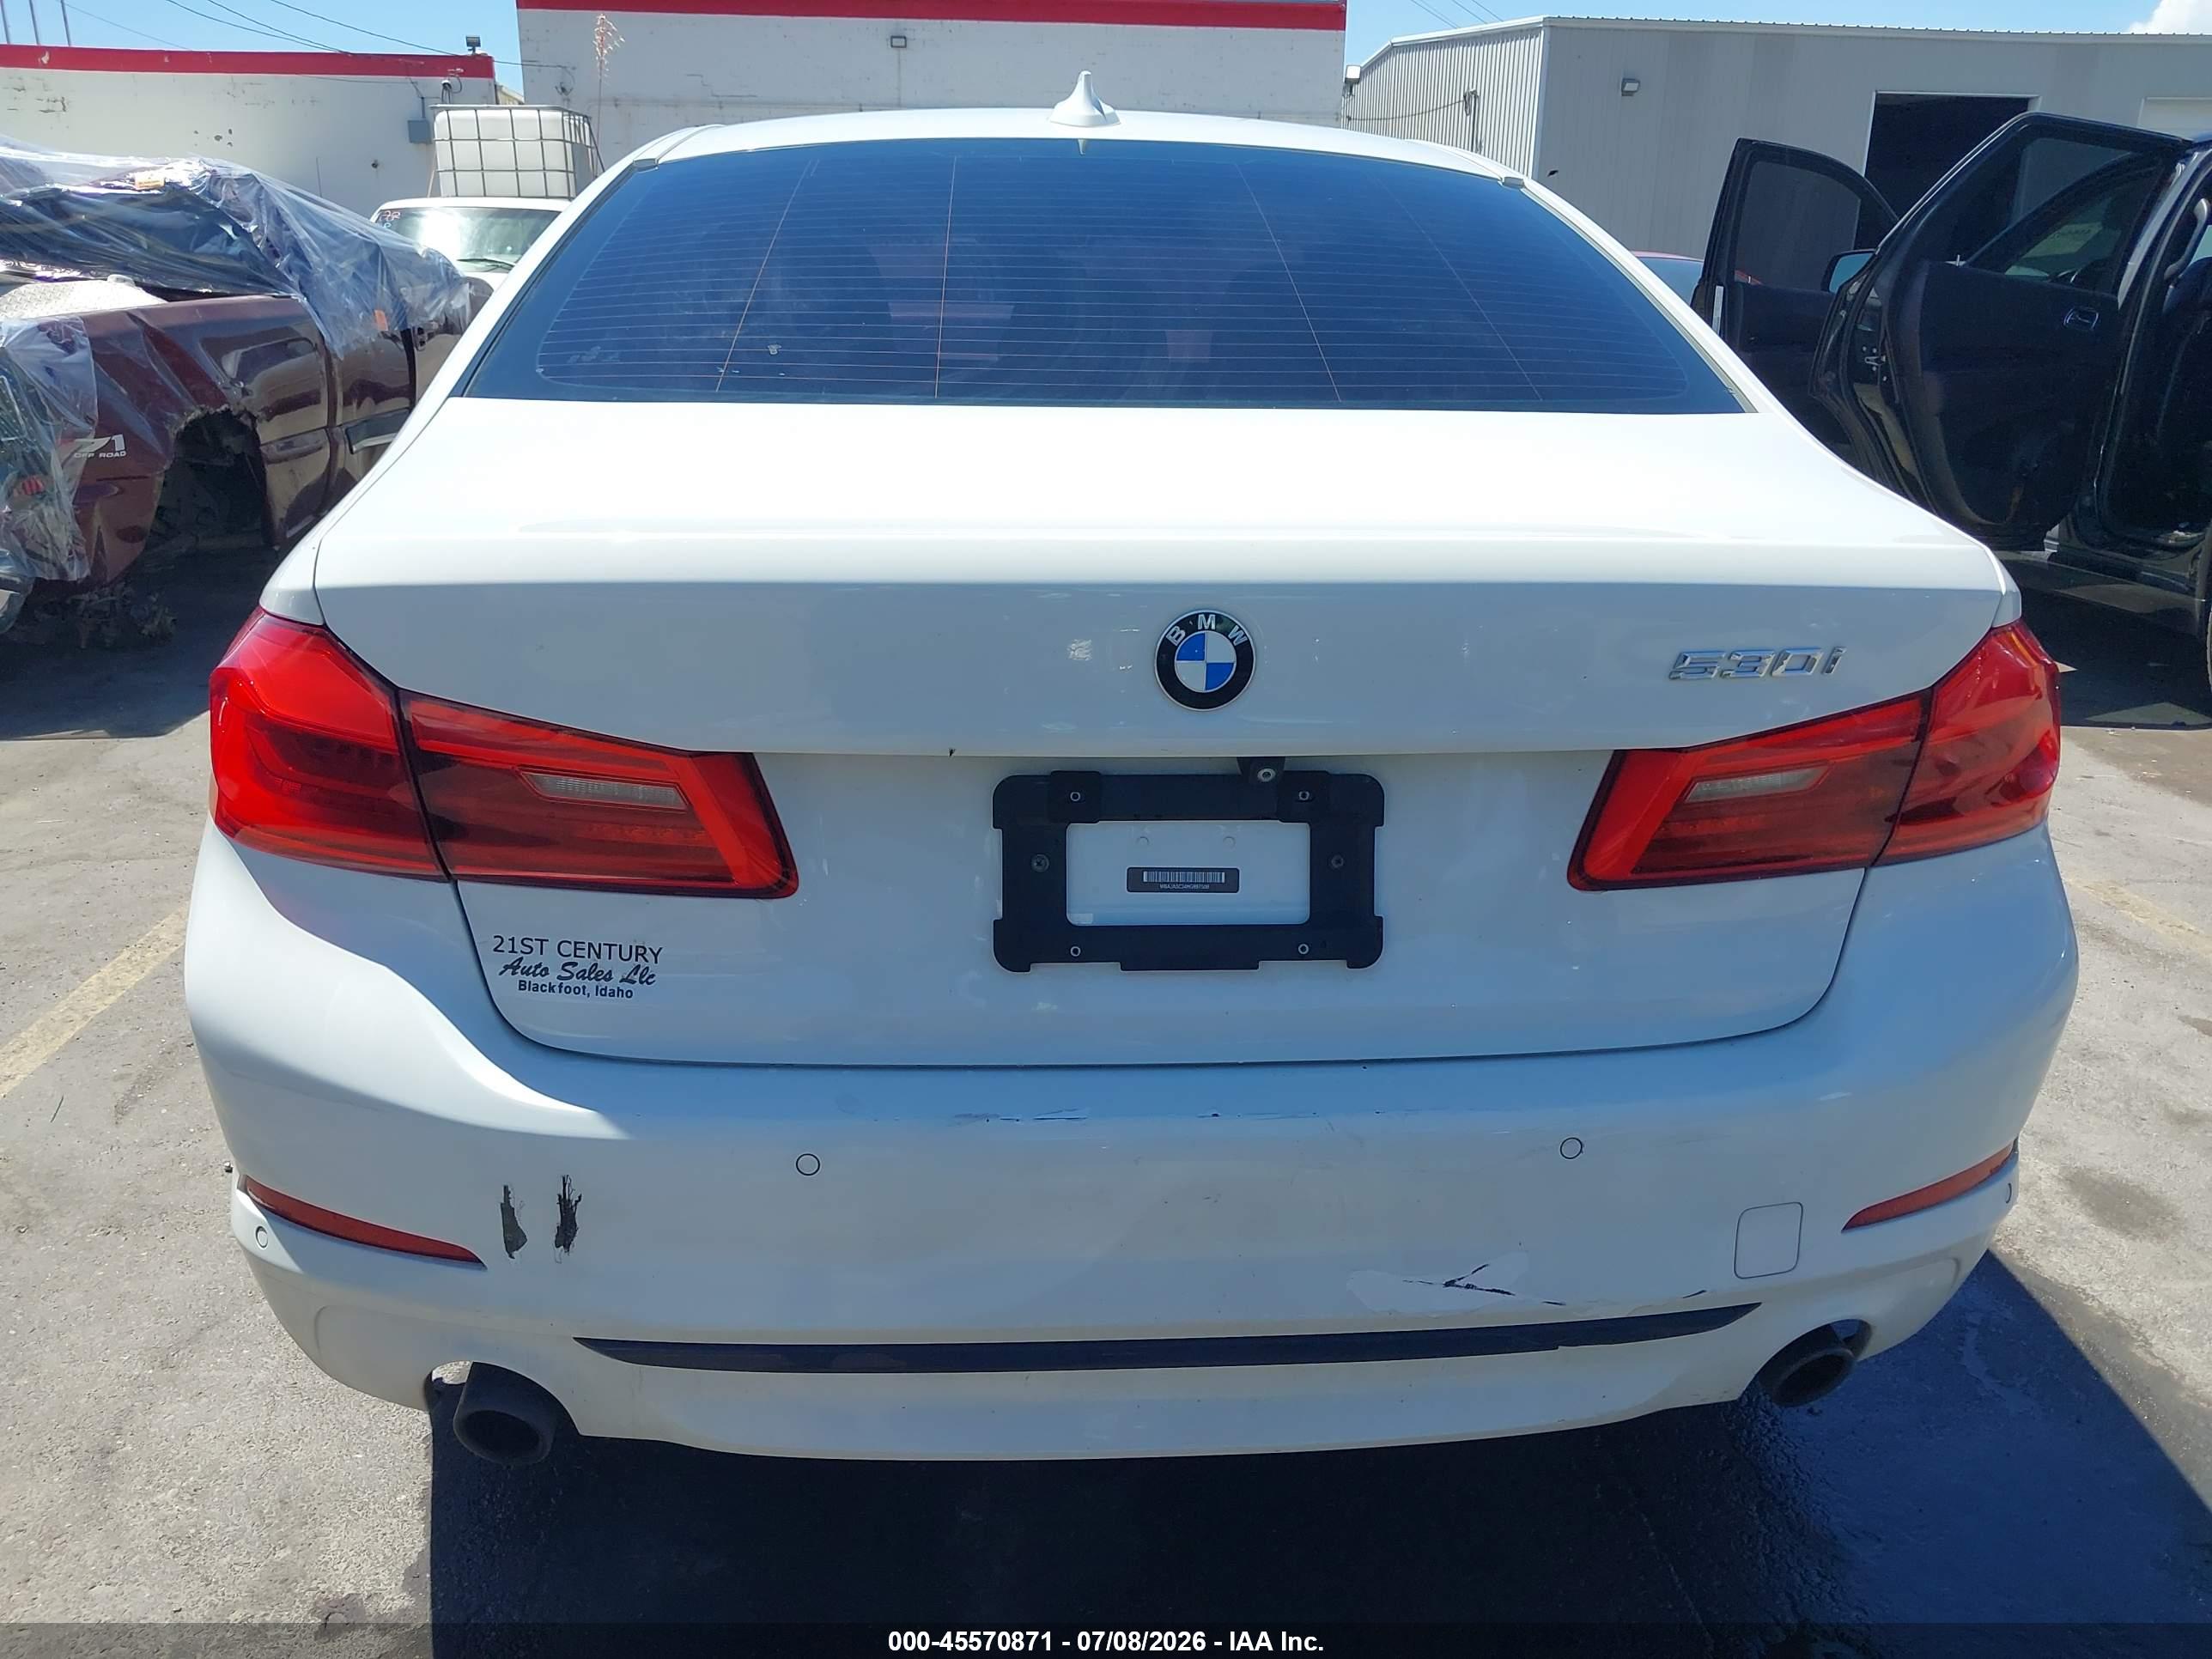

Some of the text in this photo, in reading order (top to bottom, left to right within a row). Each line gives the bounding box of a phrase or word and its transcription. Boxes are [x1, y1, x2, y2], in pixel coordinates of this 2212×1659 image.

[61, 434, 125, 452] 71
[1165, 613, 1249, 647] BMW
[1668, 646, 1847, 680] 530i
[492, 935, 664, 964] 21ST CENTURY
[498, 956, 657, 986] Auto Sales Llc
[518, 980, 634, 999] Blackfoot, Idaho
